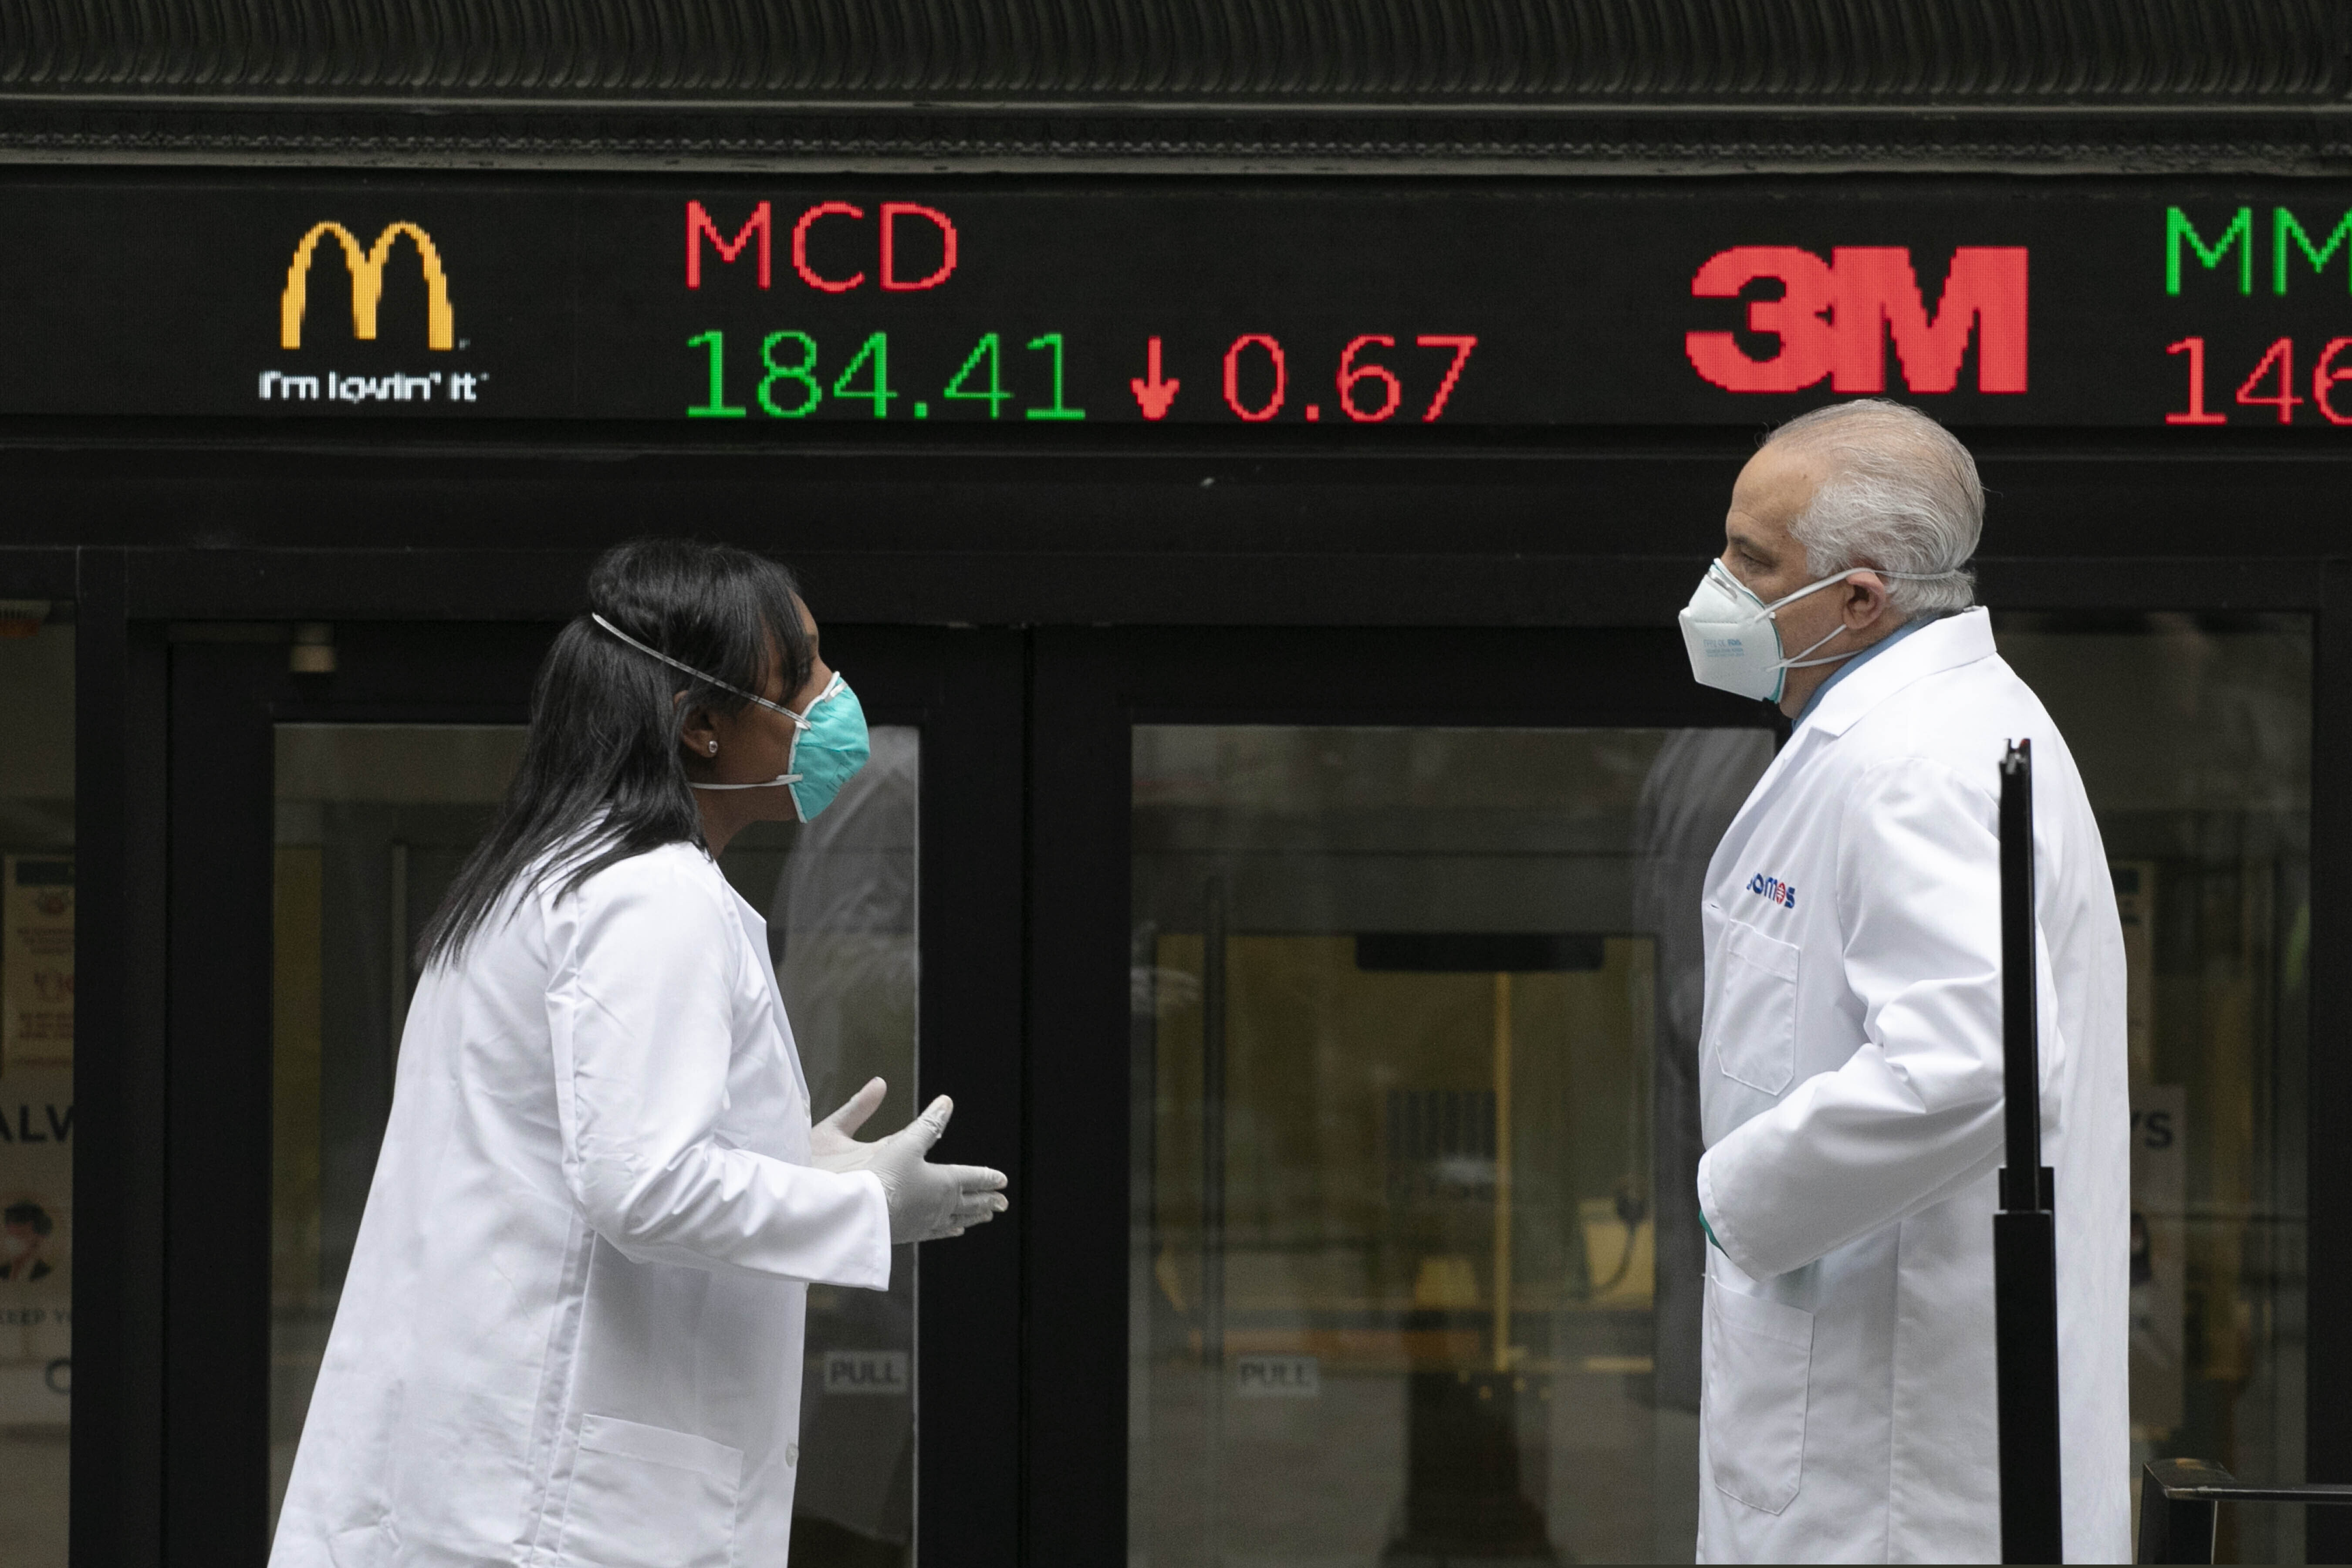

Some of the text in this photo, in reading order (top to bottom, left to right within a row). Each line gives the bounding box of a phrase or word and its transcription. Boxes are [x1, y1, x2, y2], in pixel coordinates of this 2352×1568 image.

[686, 199, 958, 294] MCD
[1685, 245, 2029, 394] 3M
[687, 331, 1478, 422] 184.41 0.67
[831, 1361, 901, 1384] PULL
[1240, 1364, 1309, 1386] PULL
